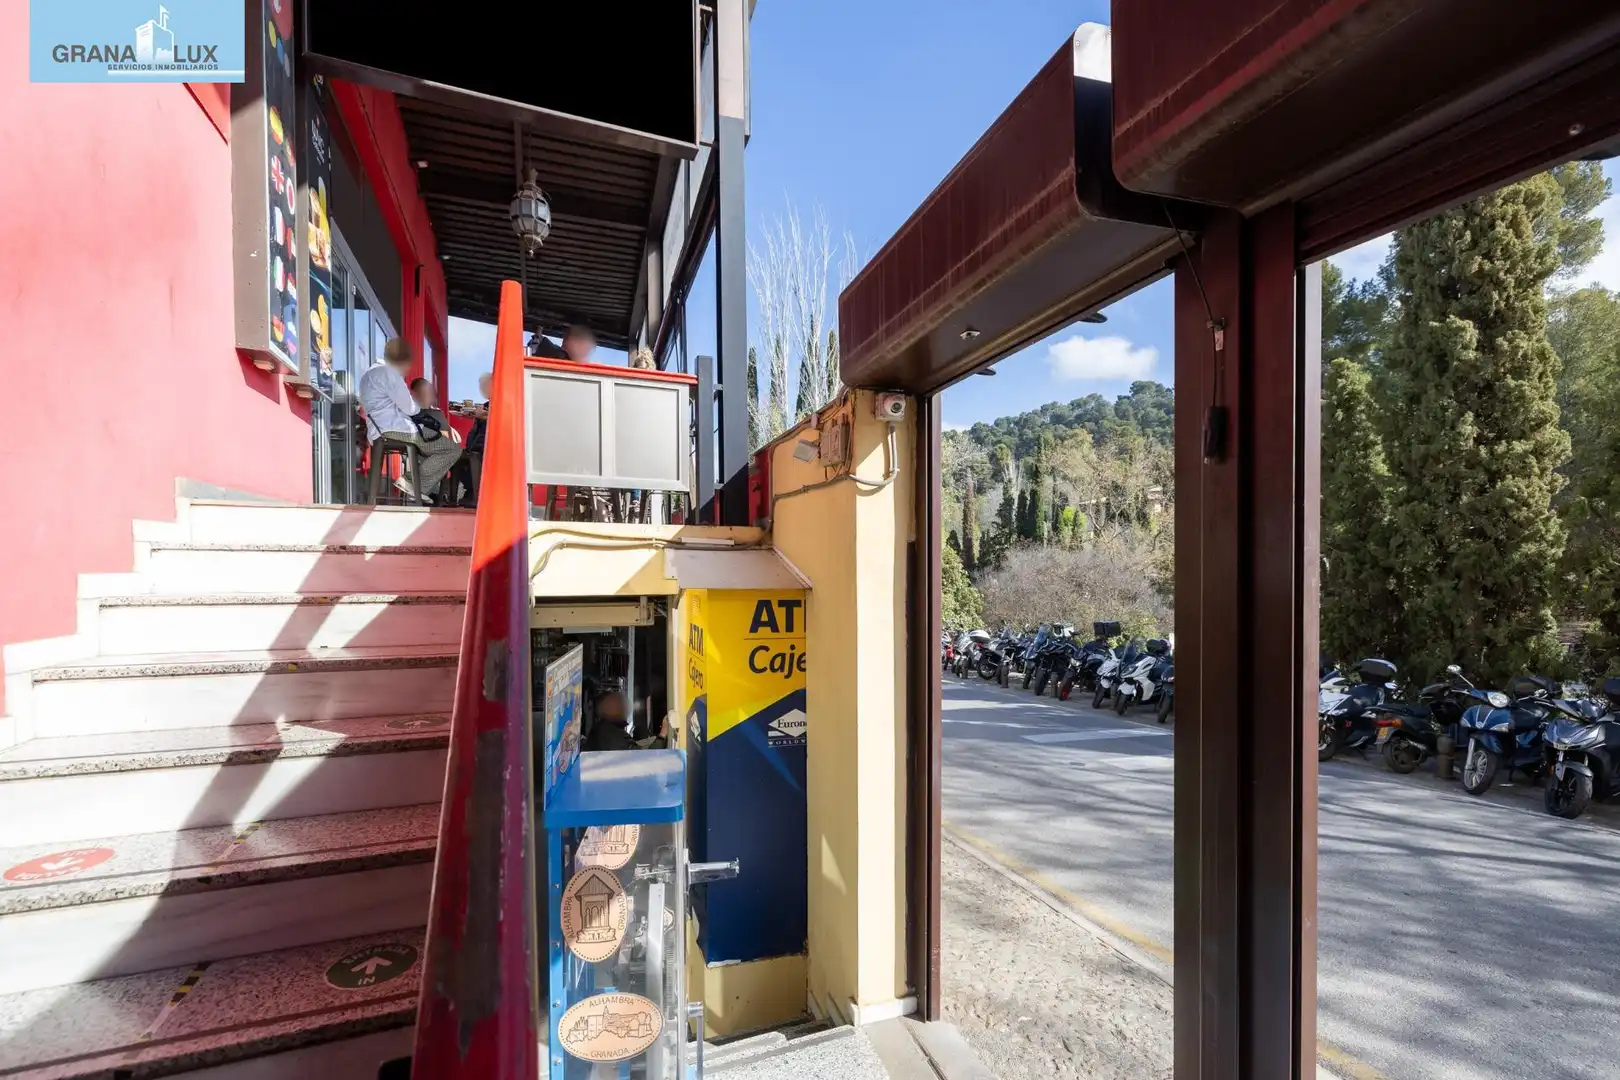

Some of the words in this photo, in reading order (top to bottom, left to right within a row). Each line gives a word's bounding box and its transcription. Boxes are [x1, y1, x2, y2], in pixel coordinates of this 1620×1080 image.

[749, 599, 806, 633] AT
[688, 623, 704, 656] ATM
[777, 719, 807, 729] Euron
[563, 896, 576, 938] ALHAMBRA
[617, 892, 626, 931] GRANADA
[358, 976, 376, 986] IN
[588, 996, 635, 1009] ALHAMBRA
[590, 1047, 630, 1058] GRANADA
